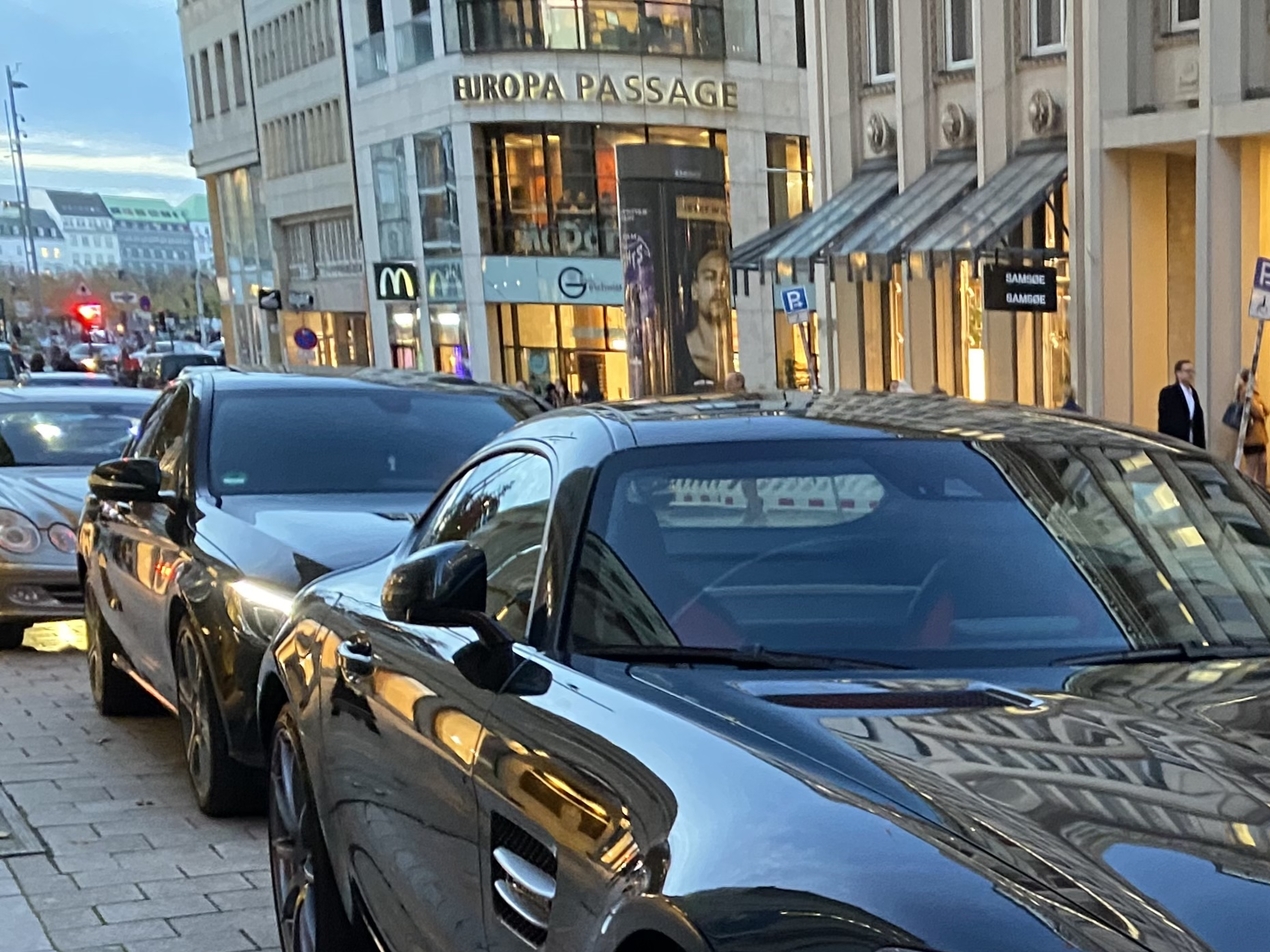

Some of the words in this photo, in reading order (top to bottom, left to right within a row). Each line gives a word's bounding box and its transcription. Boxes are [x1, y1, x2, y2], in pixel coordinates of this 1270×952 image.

[452, 72, 565, 102] EUROPA
[576, 73, 738, 109] PASSAGE
[786, 290, 801, 310] P
